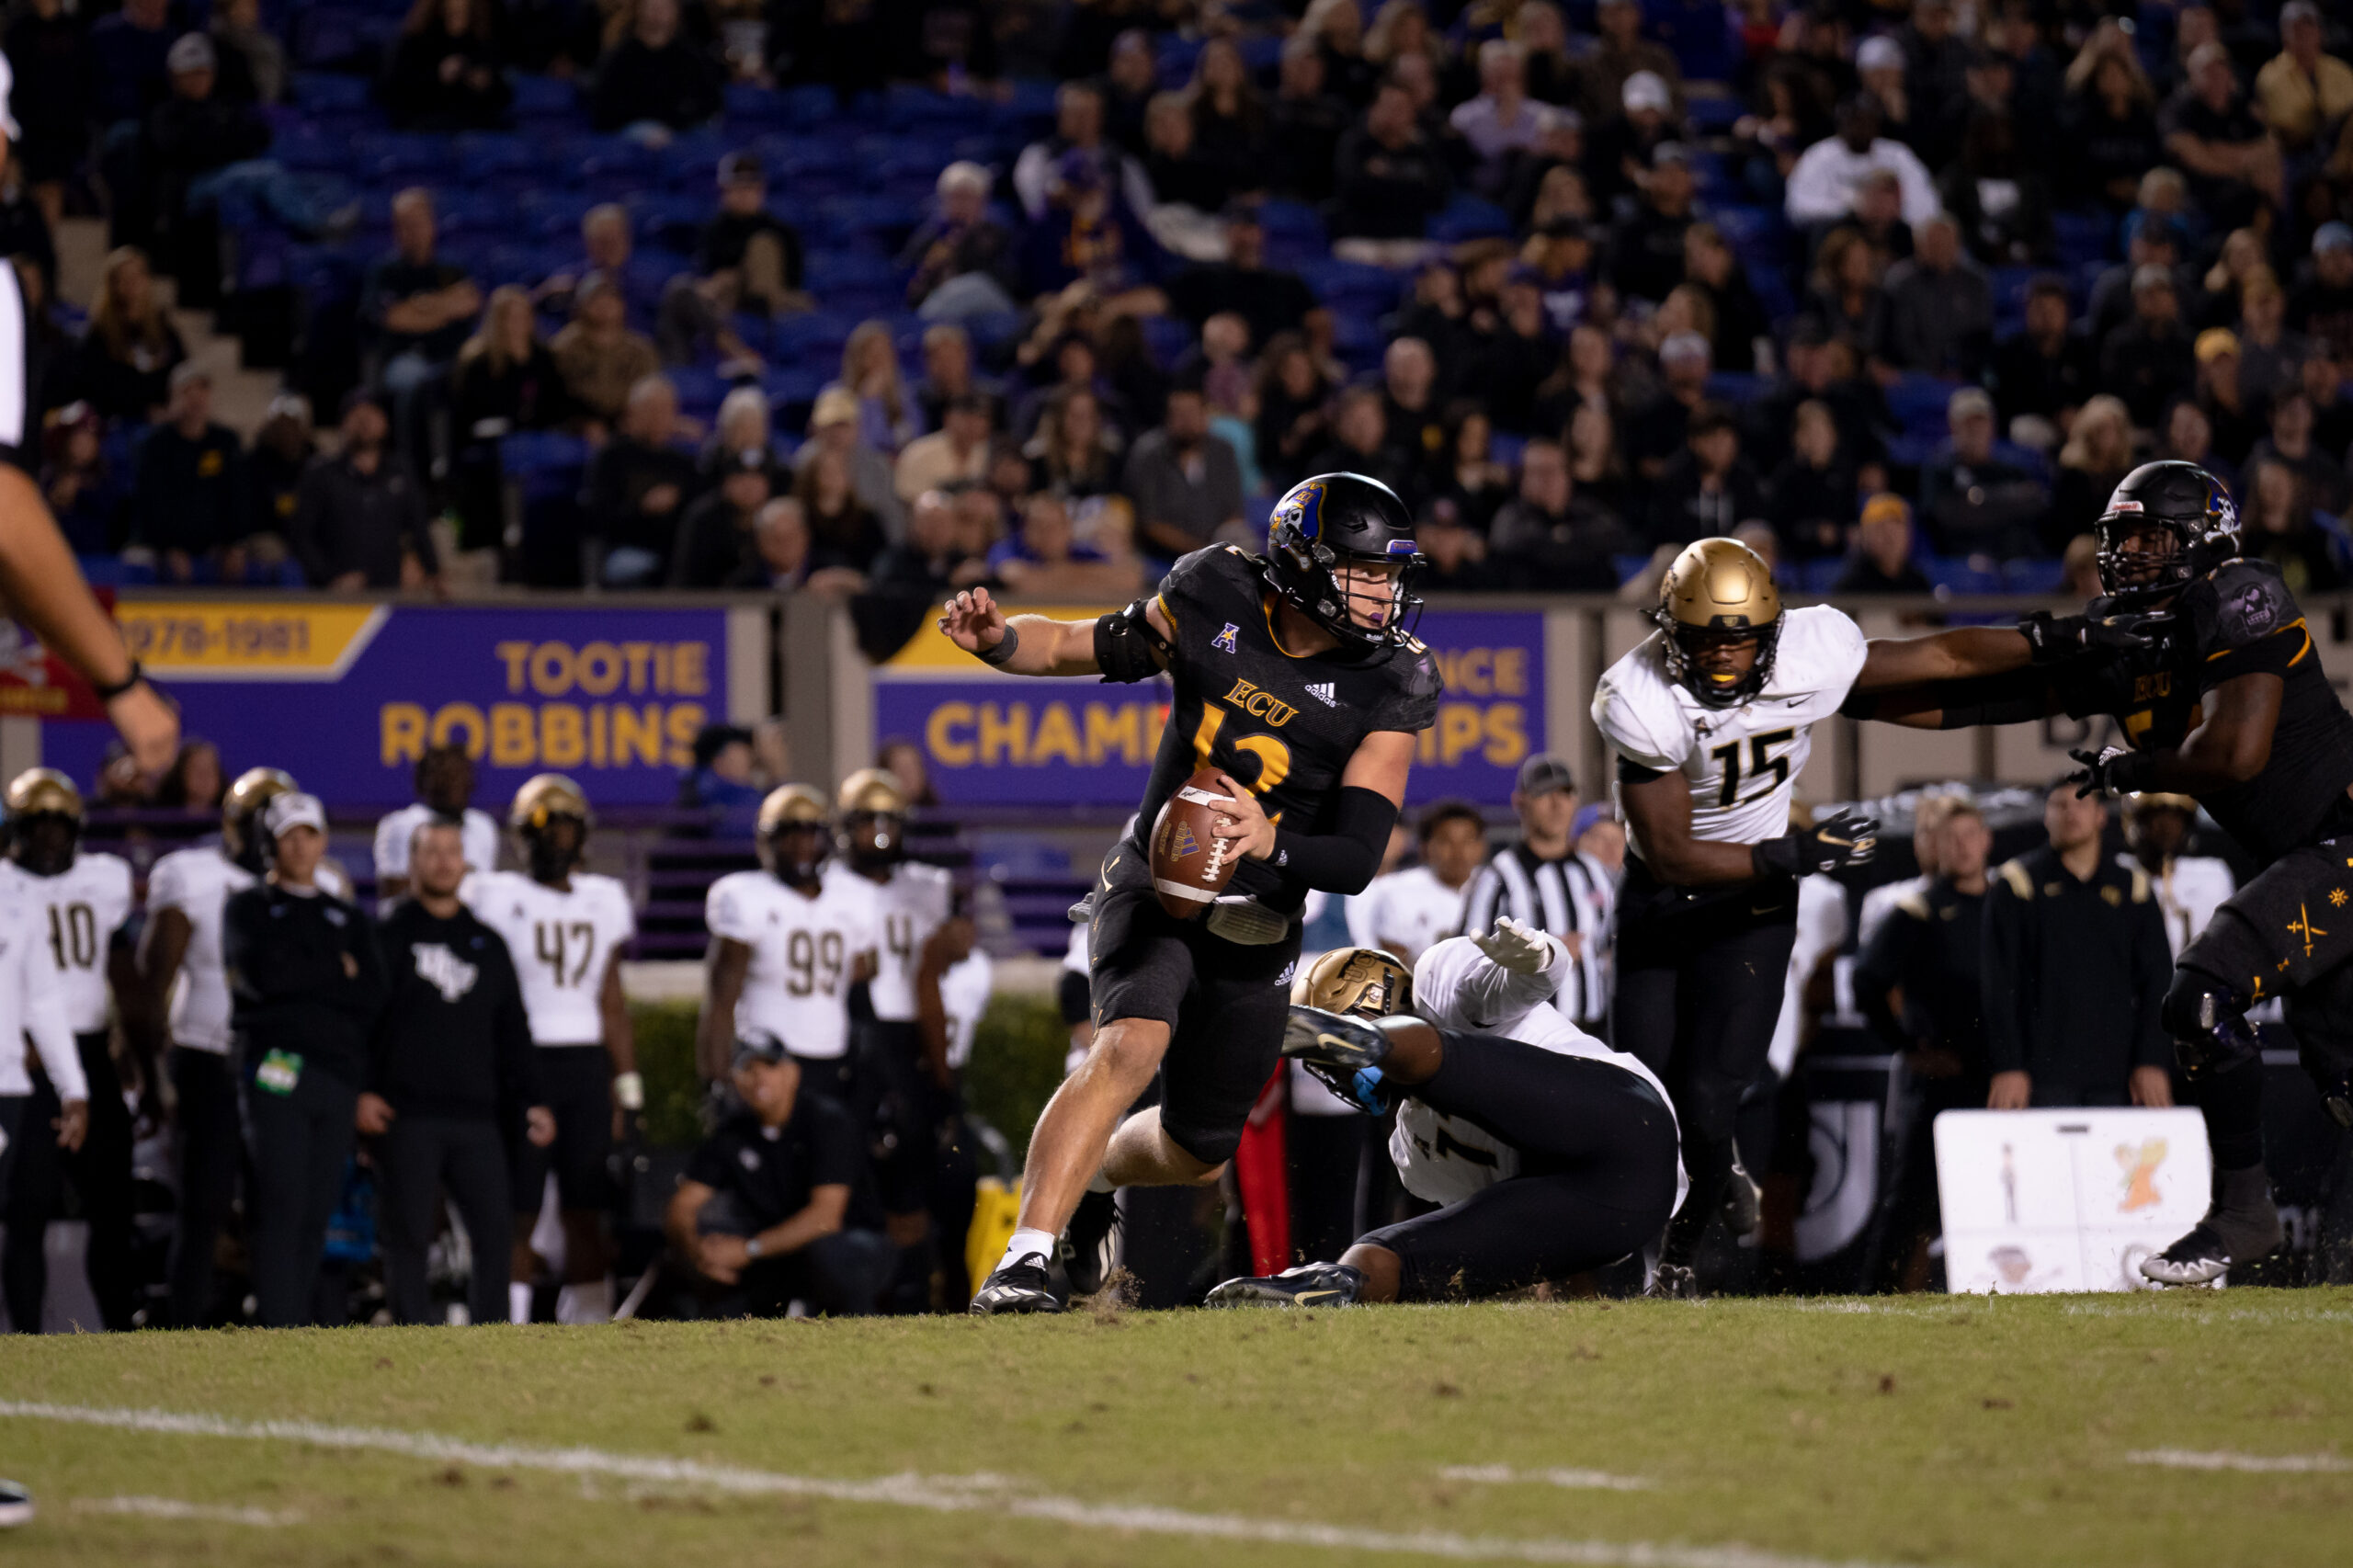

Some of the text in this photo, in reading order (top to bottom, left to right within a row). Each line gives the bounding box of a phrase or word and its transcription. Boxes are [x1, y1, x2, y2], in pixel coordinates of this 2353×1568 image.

[495, 639, 710, 697] TOOTIE
[1304, 684, 1336, 708] adidas
[379, 701, 709, 768] ROBBINS
[1222, 677, 1301, 727] ECU
[1711, 725, 1795, 811] 15
[535, 919, 595, 989] 47
[785, 928, 844, 997] 99
